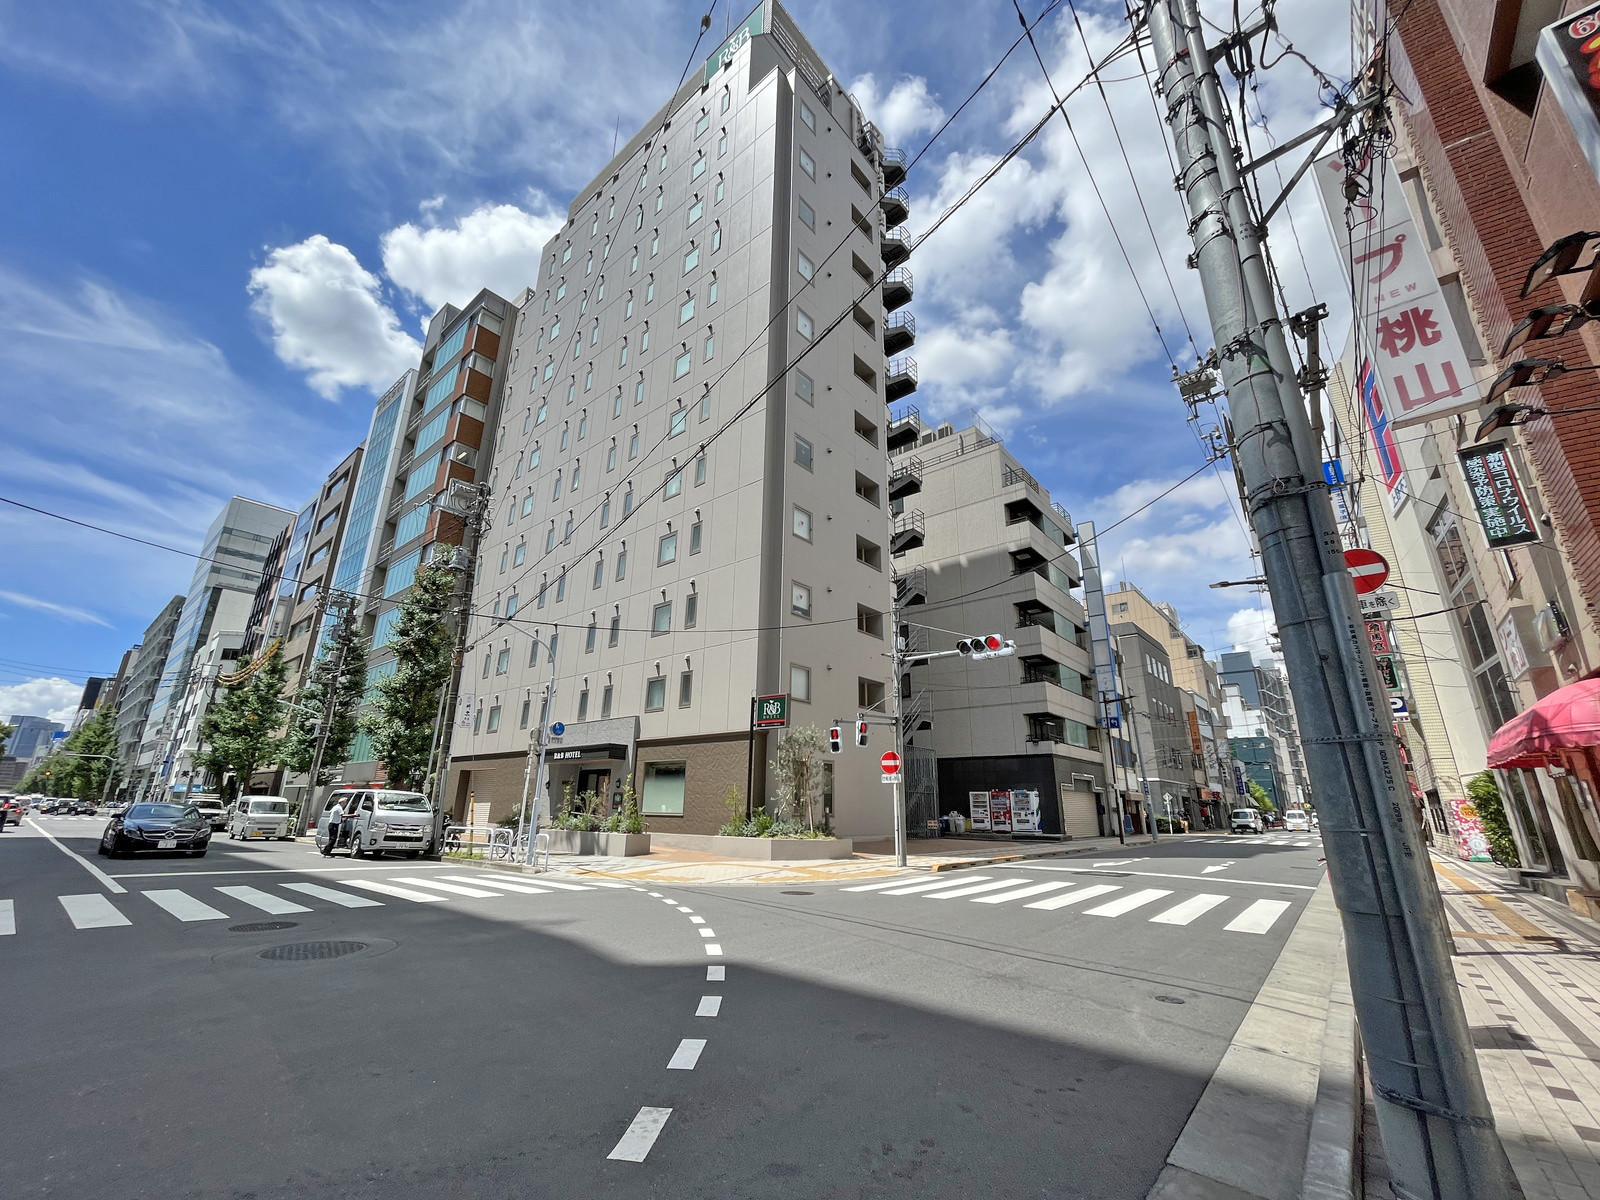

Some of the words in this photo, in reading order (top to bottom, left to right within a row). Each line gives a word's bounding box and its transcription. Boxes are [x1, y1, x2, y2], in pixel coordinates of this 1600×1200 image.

[718, 27, 751, 68] R&B
[1374, 282, 1418, 304] NEW
[1376, 306, 1464, 411] 桃山
[1486, 451, 1531, 535] 新型コロナウイルス
[764, 700, 781, 715] R&B
[554, 752, 564, 760] R&B
[565, 751, 581, 759] HOTEL
